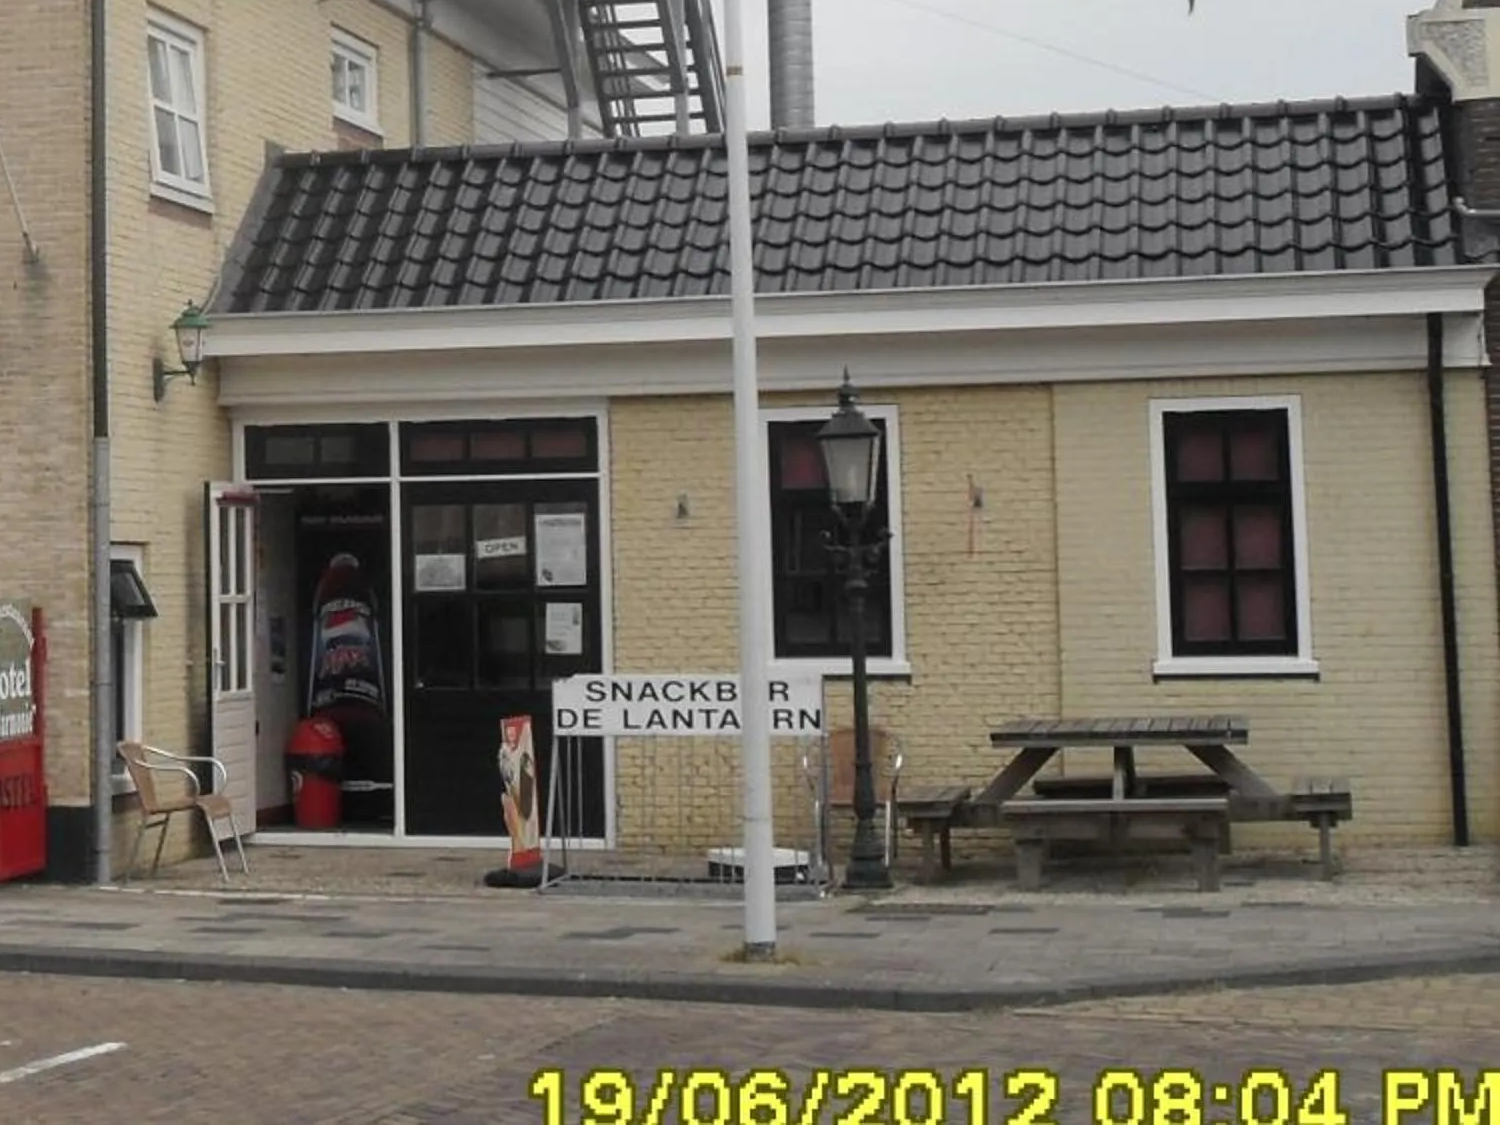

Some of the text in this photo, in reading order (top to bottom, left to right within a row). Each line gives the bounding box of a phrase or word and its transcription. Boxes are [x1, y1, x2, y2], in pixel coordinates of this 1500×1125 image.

[484, 541, 519, 554] OPEN
[584, 679, 791, 703] SNACKBR
[556, 707, 822, 730] DE LANTARN
